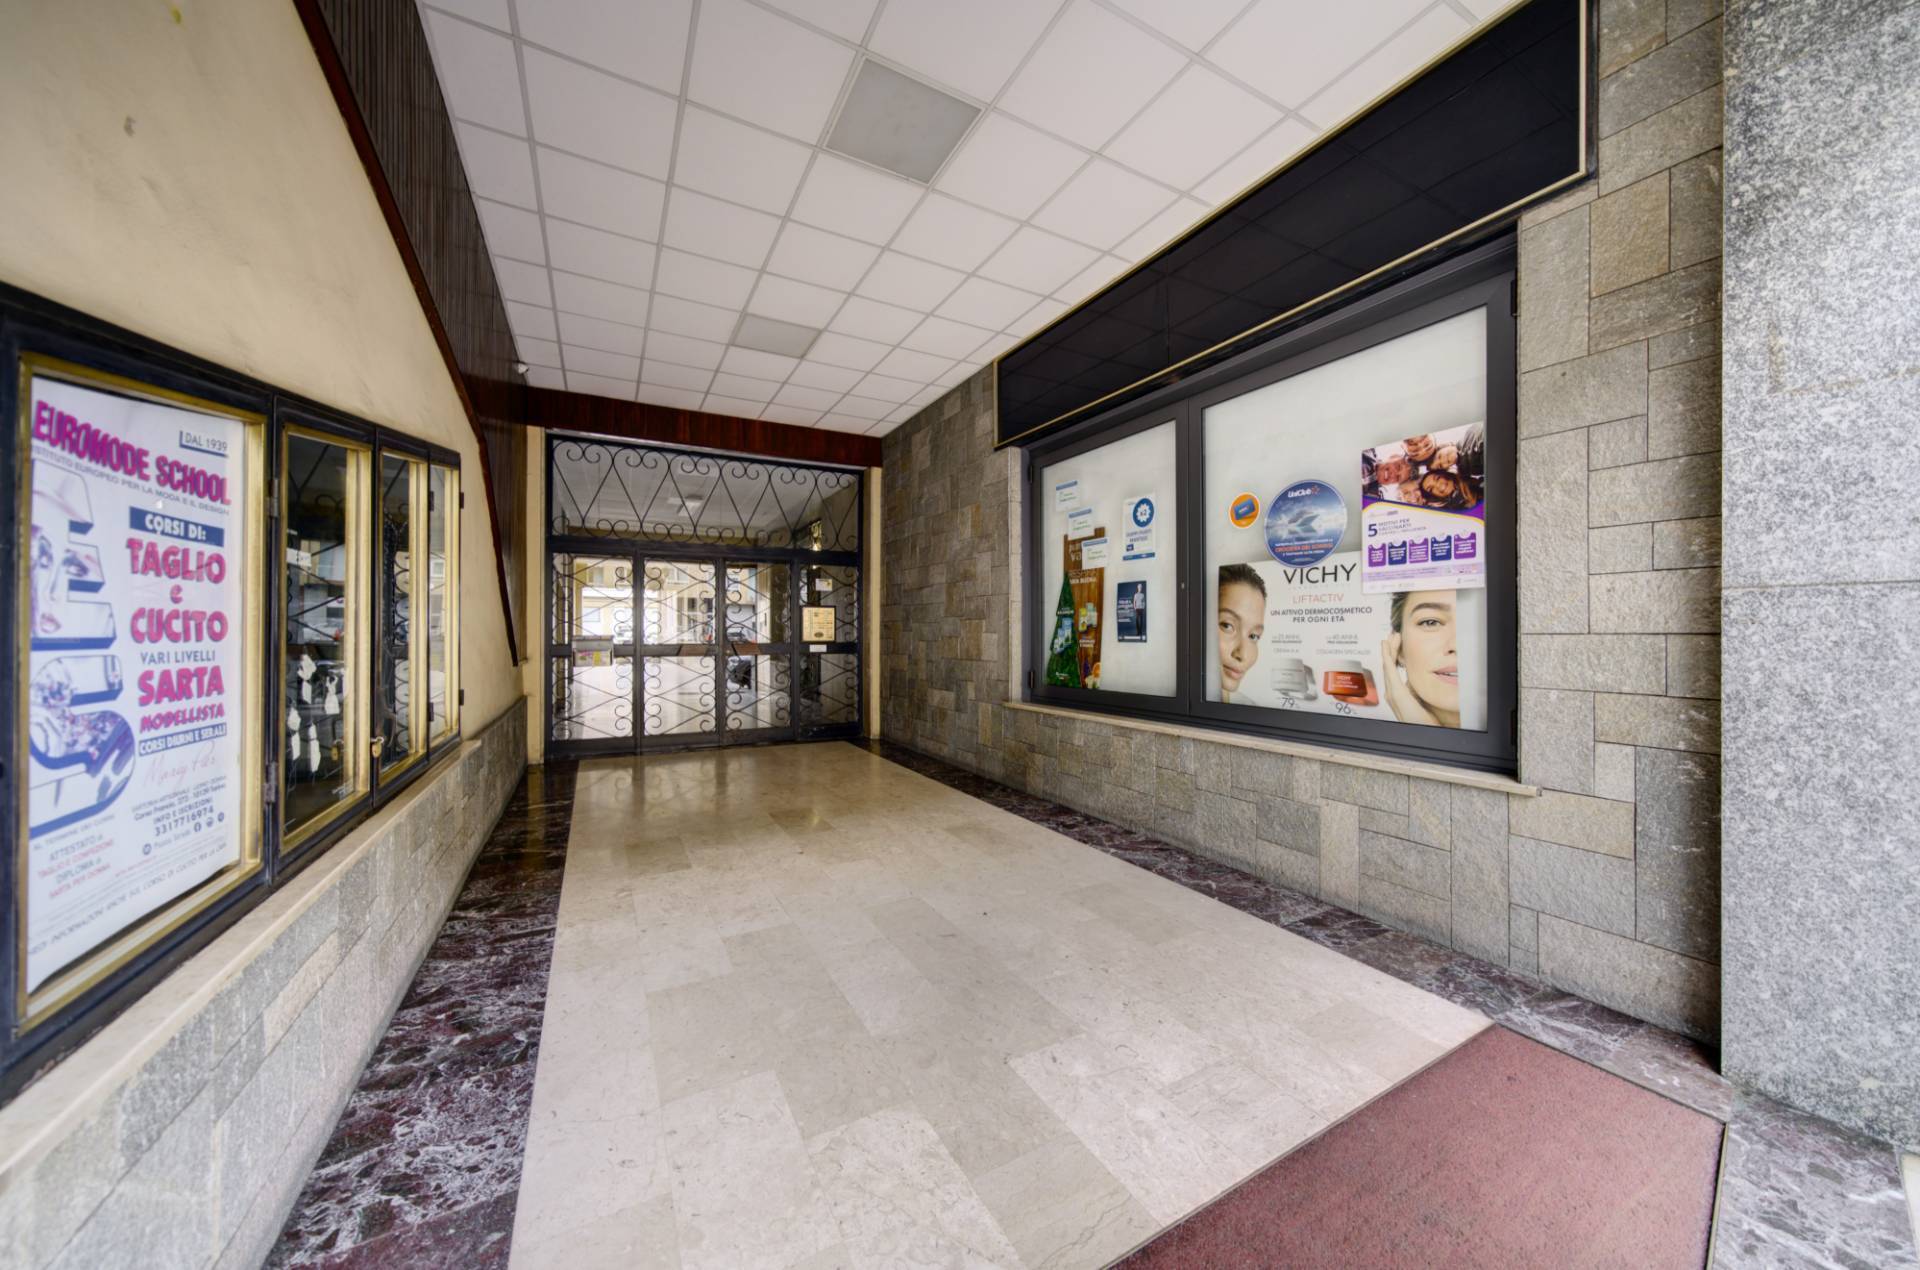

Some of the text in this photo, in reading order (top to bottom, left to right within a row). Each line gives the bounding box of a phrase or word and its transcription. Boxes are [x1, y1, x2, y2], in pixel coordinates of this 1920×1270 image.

[185, 431, 228, 451] DAL 1939
[33, 400, 231, 505] EUROMODE SCHOOL
[145, 511, 207, 541] CORSI DI:
[1368, 523, 1378, 537] 5
[126, 538, 226, 584] TAGLIO
[1283, 562, 1357, 585] VICHY
[170, 584, 183, 604] e
[1292, 593, 1345, 604] LIFTACTIV
[1270, 606, 1373, 616] UN ATTIVO DERMOCOSMETICO
[130, 608, 229, 644] CUCITO
[140, 649, 216, 665] VARI LIVELLI
[138, 665, 225, 707] SARTA
[140, 702, 225, 733] MODELLISTA
[140, 740, 166, 756] CORSI
